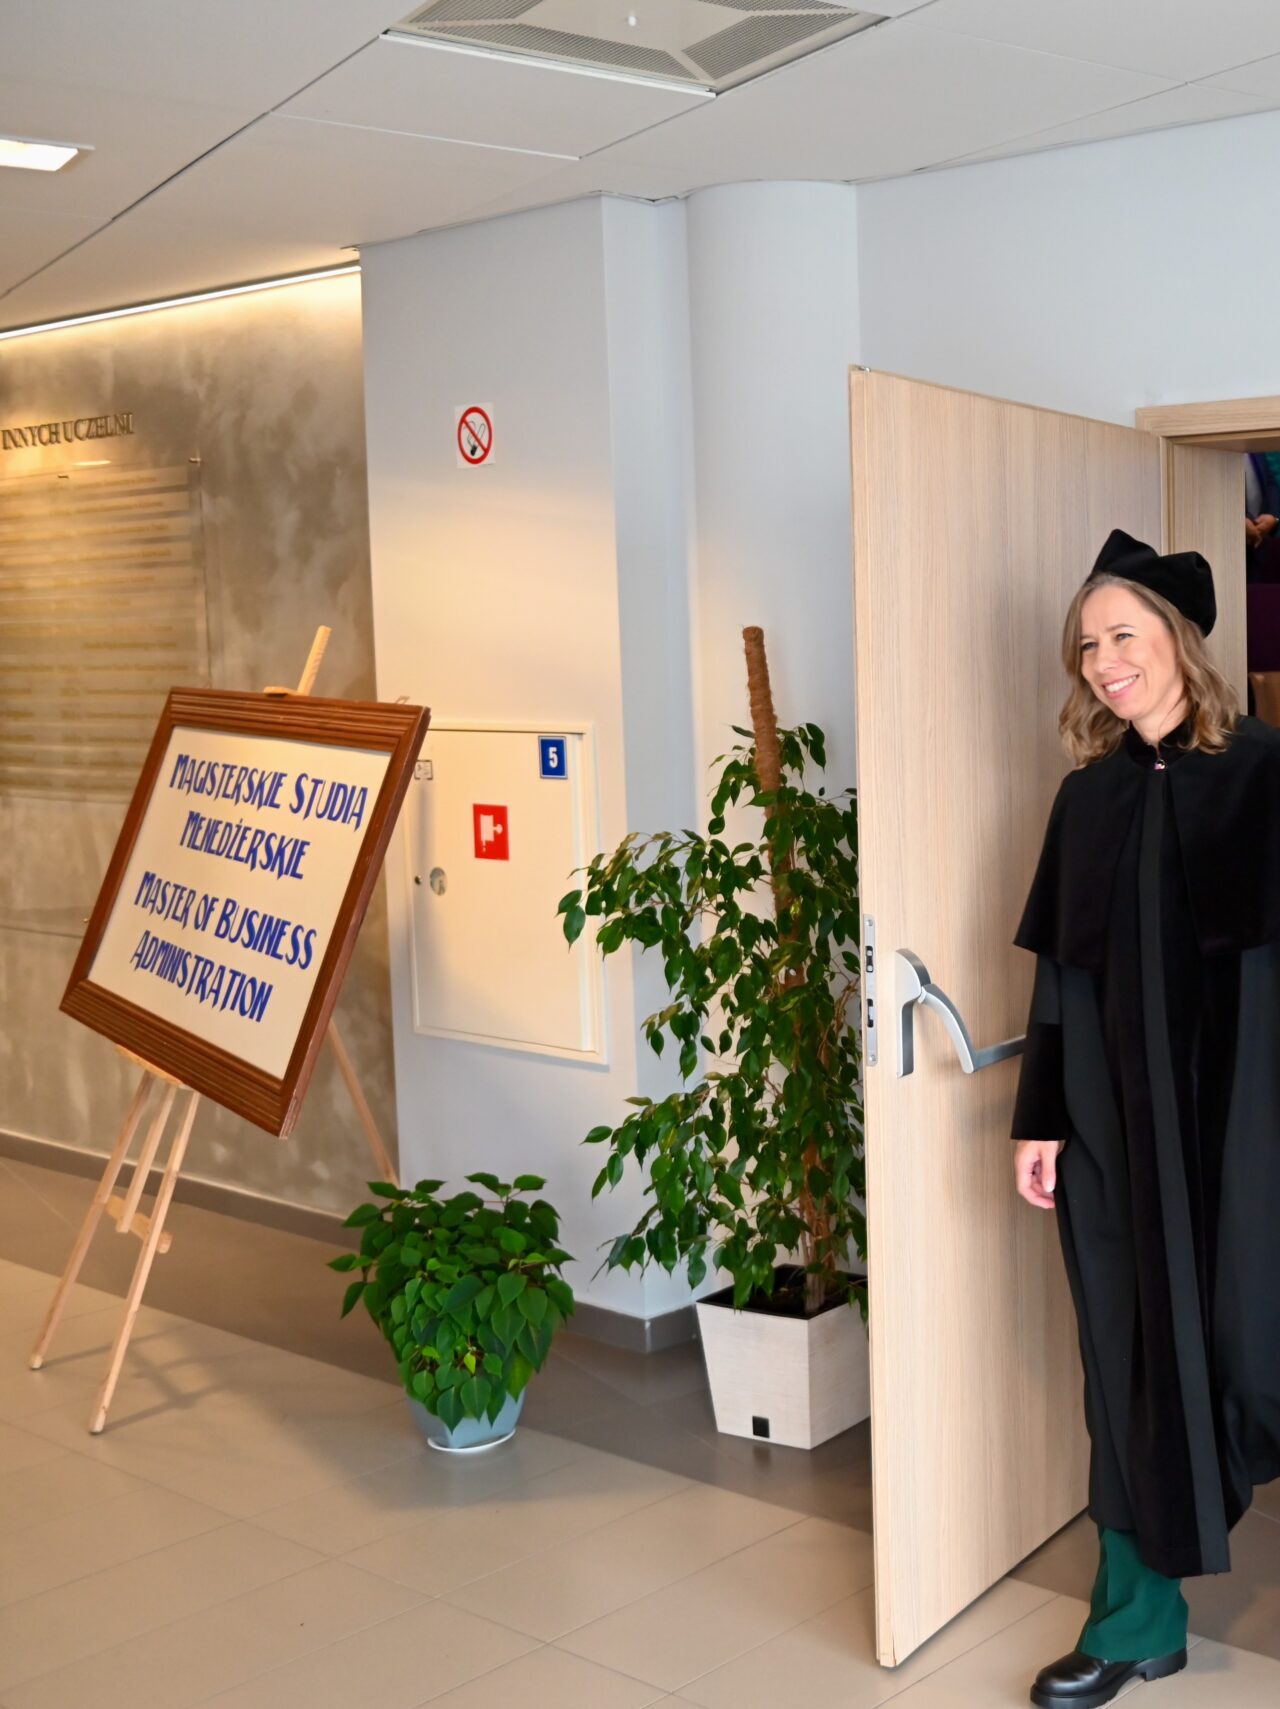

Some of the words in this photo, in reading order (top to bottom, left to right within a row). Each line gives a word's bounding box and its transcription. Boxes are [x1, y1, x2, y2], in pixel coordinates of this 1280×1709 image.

[62, 412, 135, 443] UCZELNI
[169, 754, 288, 811] MAGISTERSKIE
[289, 773, 368, 831] STUDIA
[549, 747, 558, 768] 5
[180, 810, 311, 880] MENEDŻERSKIE
[134, 871, 196, 930] MASTER
[193, 894, 219, 932] OF
[214, 898, 317, 970] BUSINESS
[129, 930, 274, 1023] ADMINISTRATION
